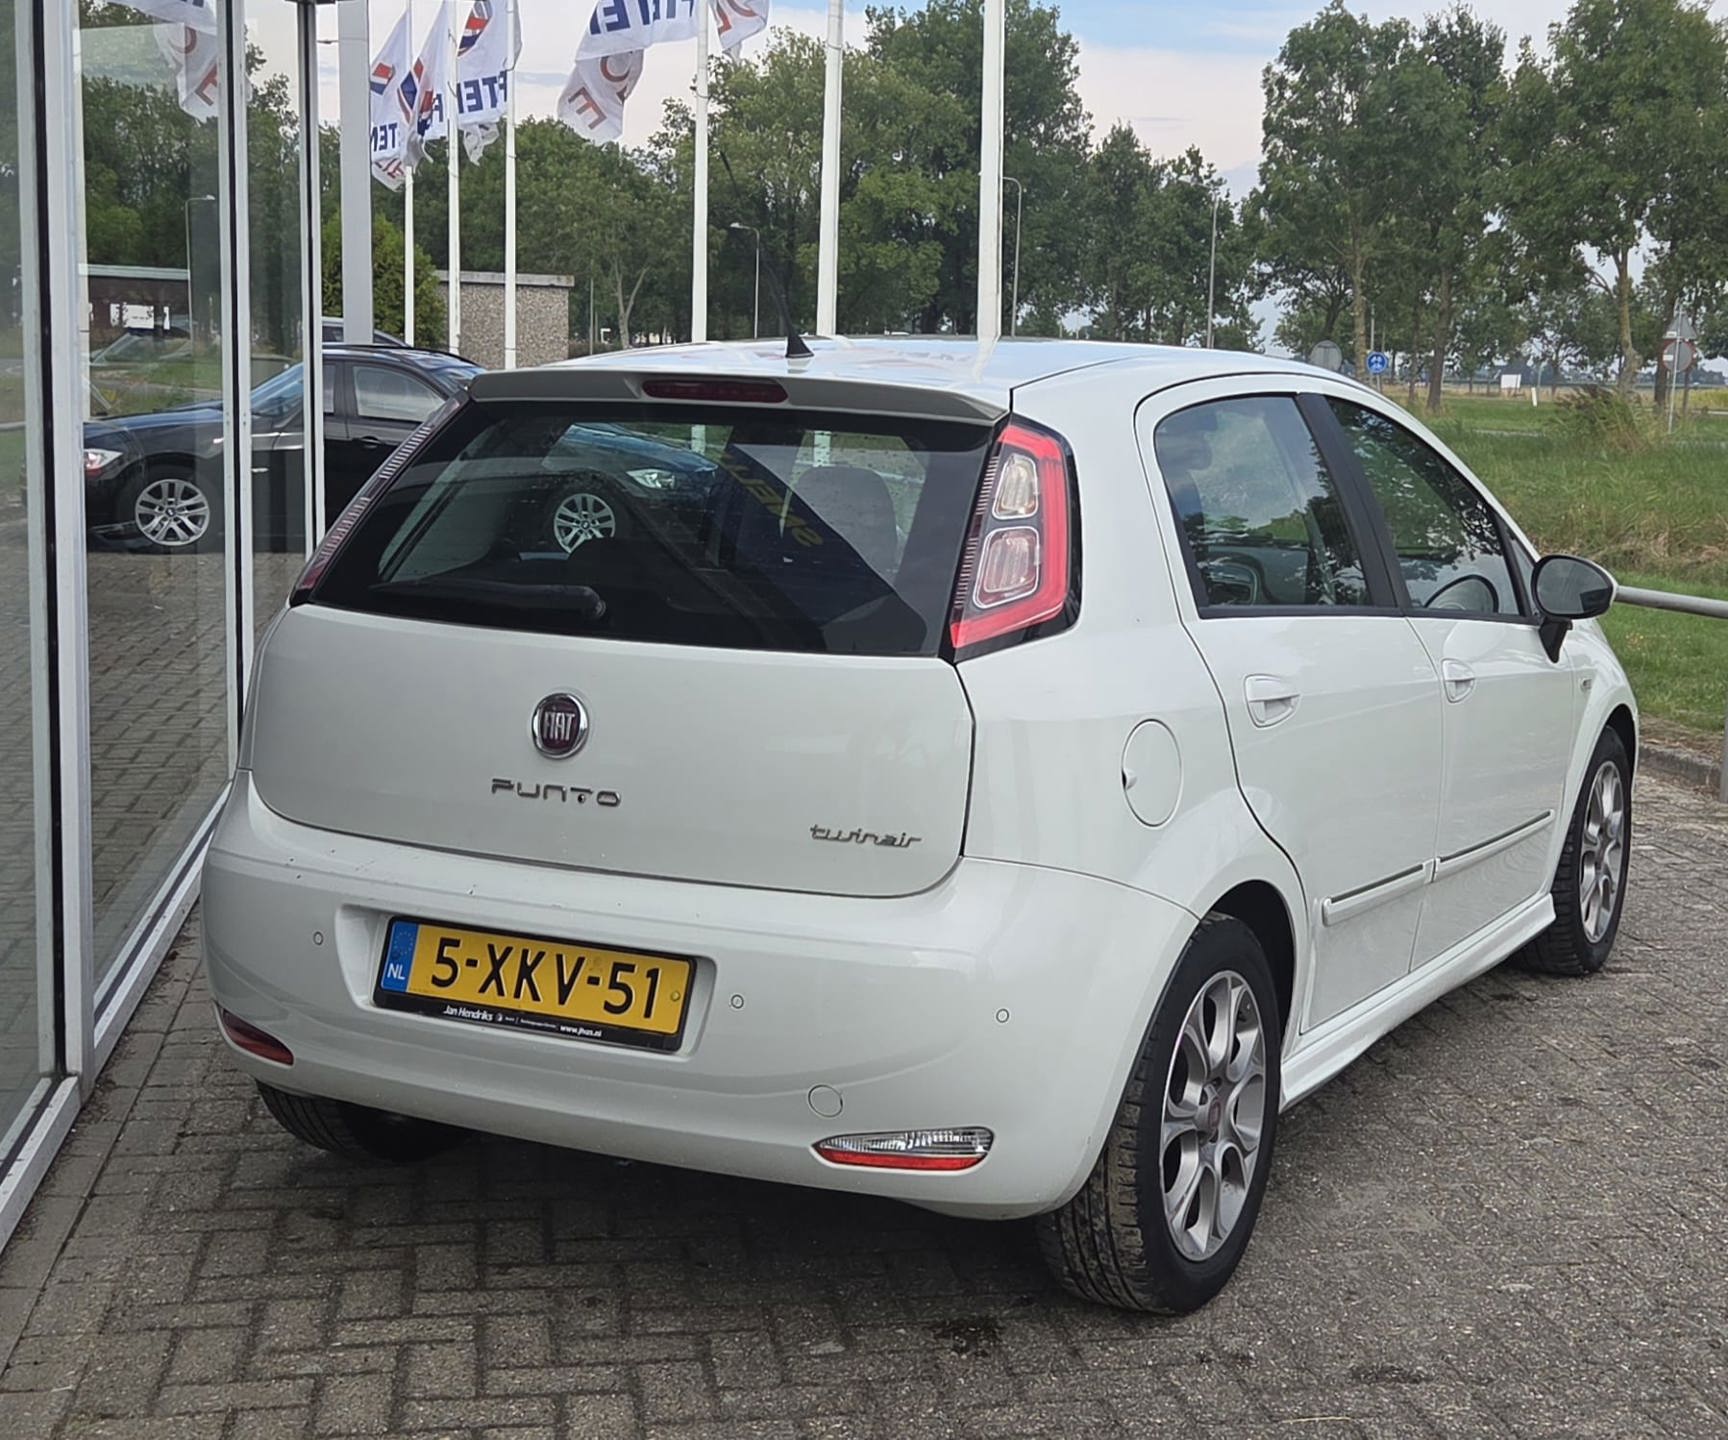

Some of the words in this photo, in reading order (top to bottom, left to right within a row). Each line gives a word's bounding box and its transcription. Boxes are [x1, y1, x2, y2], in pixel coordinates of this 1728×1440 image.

[543, 710, 576, 741] FIAT
[491, 778, 621, 807] PUNTO
[810, 824, 922, 848] twinair
[387, 963, 406, 980] NL
[430, 936, 661, 1019] 5-XKV-51
[443, 1004, 458, 1016] Jan
[458, 1007, 493, 1022] Hendriks
